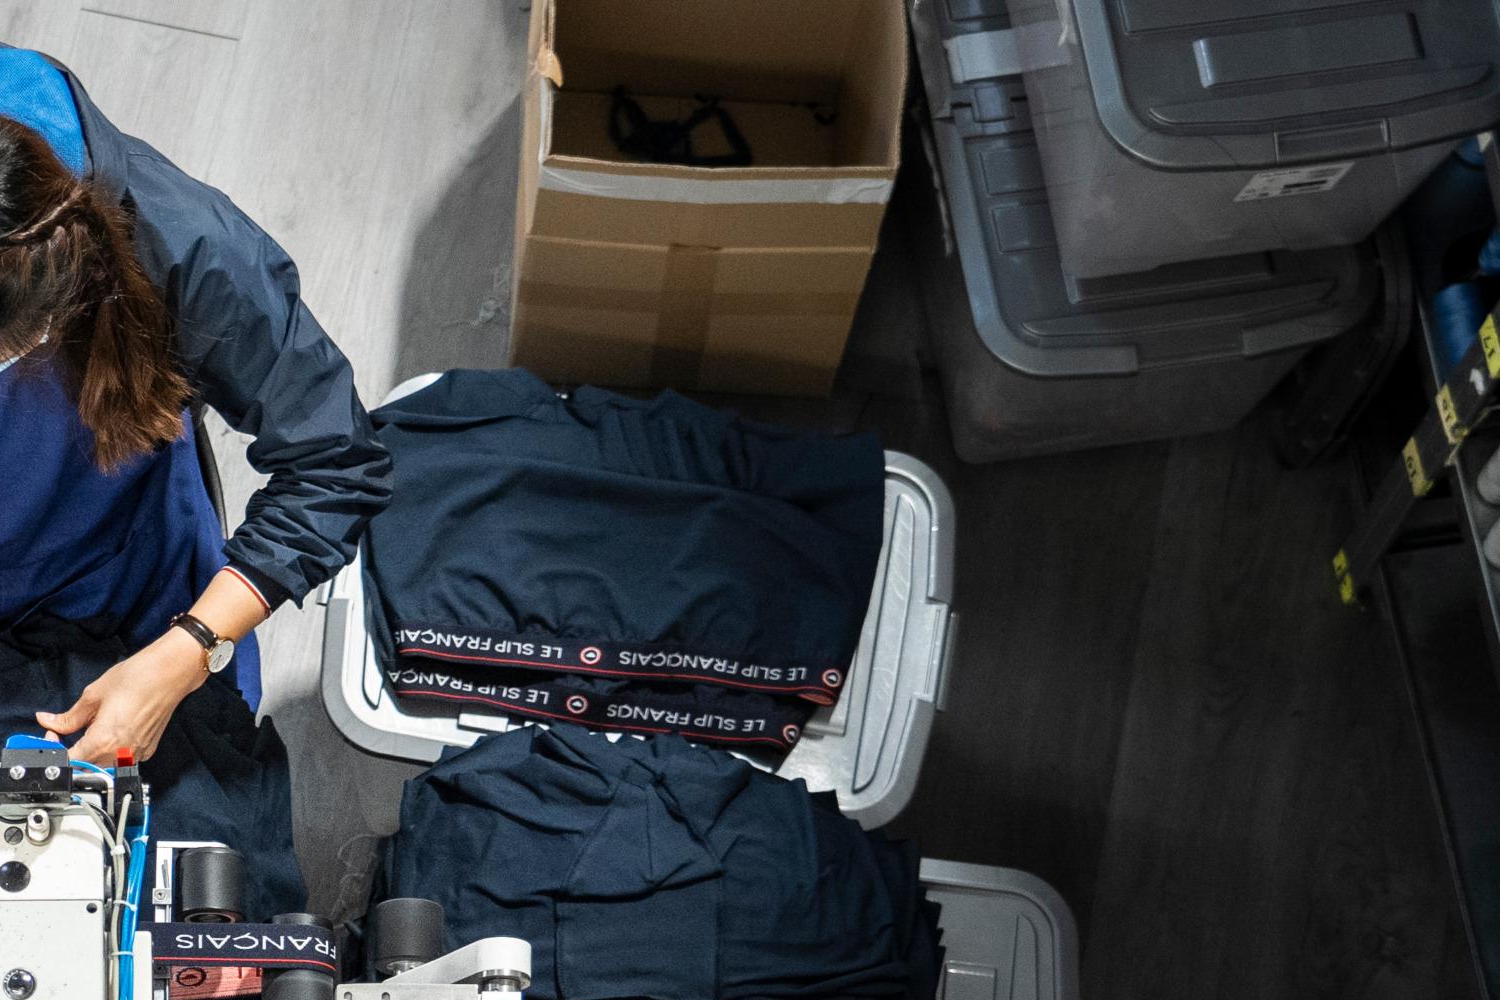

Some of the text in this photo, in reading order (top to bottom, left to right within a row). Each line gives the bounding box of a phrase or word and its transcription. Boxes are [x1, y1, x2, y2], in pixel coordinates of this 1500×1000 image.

[494, 640, 535, 656] SLIP
[540, 645, 563, 659] LE
[741, 664, 781, 681] SLIP
[786, 666, 808, 681] LE
[387, 669, 549, 705] LE SLIP FRANÇA
[693, 713, 736, 731] SLIP
[742, 718, 766, 732] LE
[175, 932, 337, 960] FRANÇAIS
